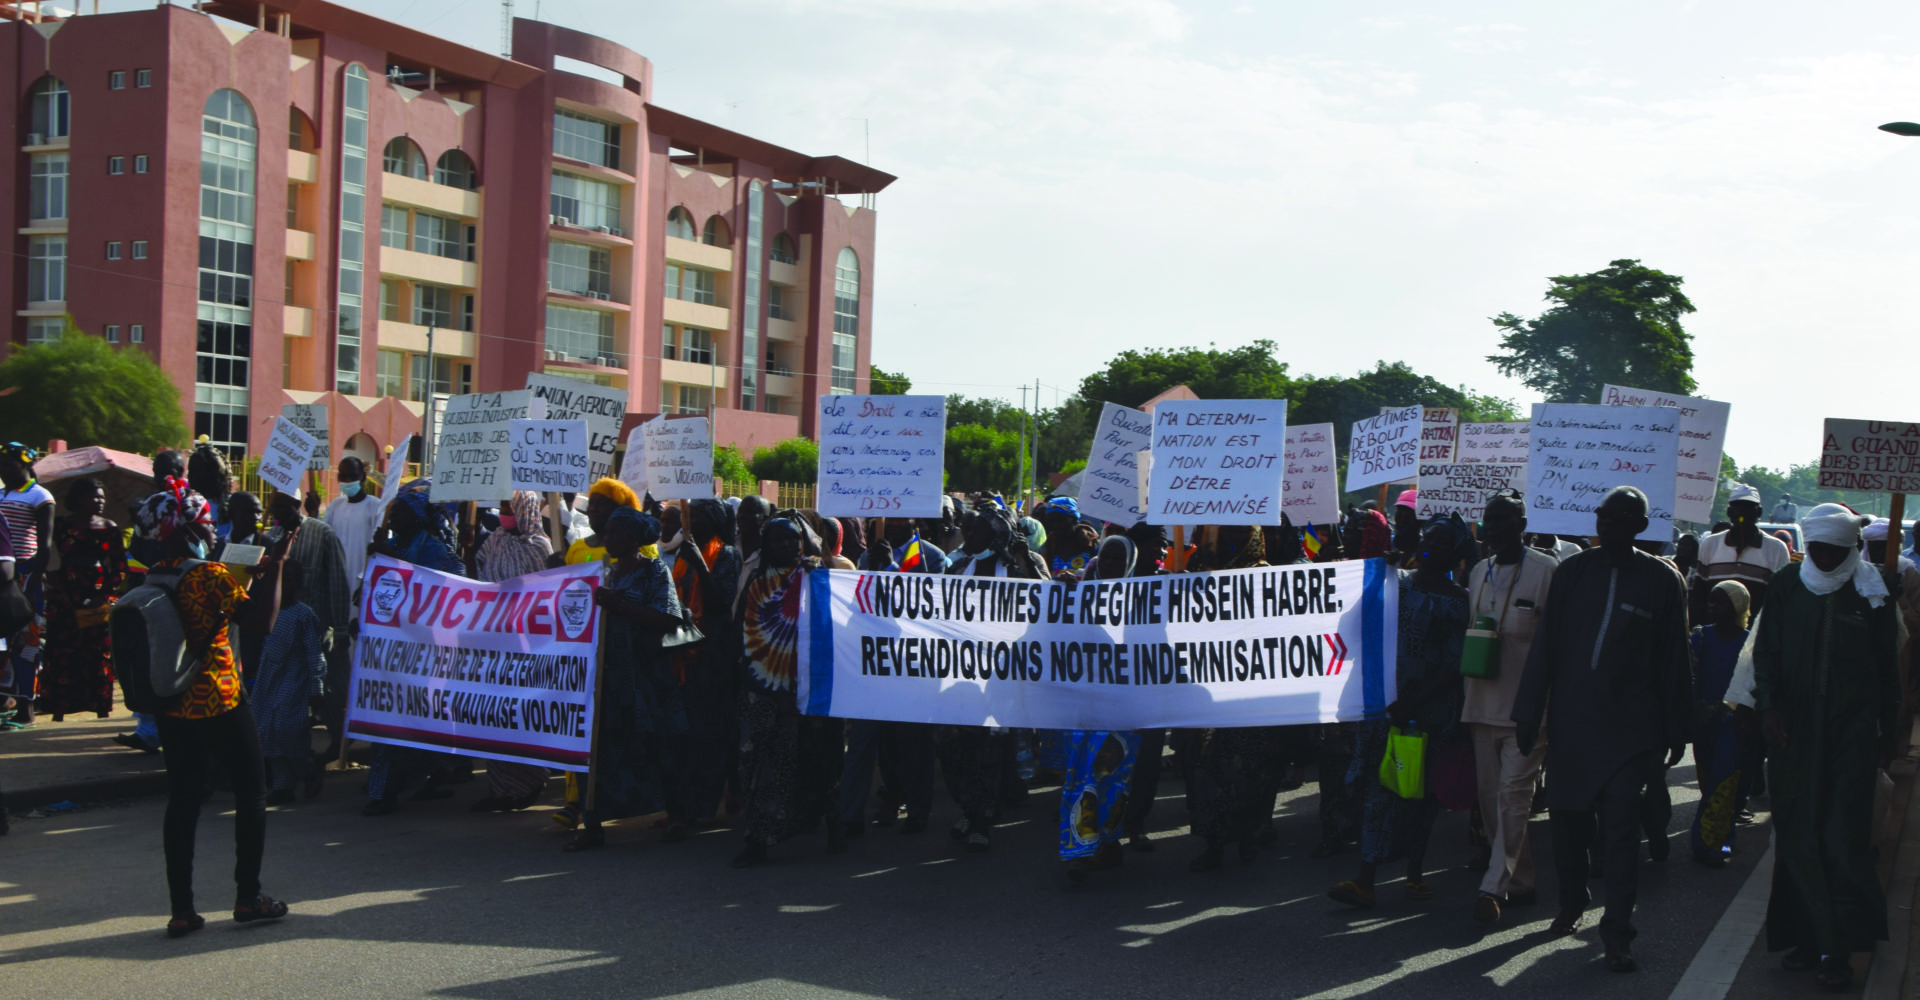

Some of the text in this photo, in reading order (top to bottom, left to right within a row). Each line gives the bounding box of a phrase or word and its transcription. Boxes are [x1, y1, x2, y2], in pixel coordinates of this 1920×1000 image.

[857, 398, 896, 418] Droit
[1422, 410, 1452, 424] LEIL
[1158, 411, 1179, 426] MA
[1357, 407, 1418, 434] VICTIMES
[1157, 434, 1217, 448] NATION
[1225, 434, 1261, 447] EST
[1421, 426, 1456, 442] RATION
[1823, 433, 1841, 451] A
[450, 448, 500, 464] VICTIMES
[534, 449, 564, 465] SONT
[567, 454, 588, 468] NOS
[1351, 438, 1418, 464] POUR VOS
[1168, 455, 1207, 470] MON
[1362, 452, 1415, 475] DROITS
[1419, 464, 1522, 478] GOUVERNEMENT
[1608, 457, 1657, 474] DROIT
[1821, 454, 1861, 470] DES
[440, 470, 455, 485] DE
[1446, 477, 1511, 490] TCHADIEN
[1539, 468, 1568, 489] PM
[1819, 471, 1885, 490] PEINES
[859, 496, 902, 511] DDS
[942, 578, 1042, 624] VICTIMES
[1047, 584, 1078, 625] DE
[1080, 580, 1163, 627] REGIME
[1168, 573, 1255, 623] HISSEIN
[1262, 567, 1343, 618] HABRE,
[408, 582, 556, 637] VICTIME
[384, 638, 426, 676] VENUE
[421, 643, 470, 683] L'HEURE
[467, 648, 486, 684] DE
[484, 649, 499, 684] TA
[499, 651, 588, 693] DETERMINATION
[861, 635, 1043, 681] REVENDIQUONS
[1050, 641, 1129, 685] NOTRE
[356, 678, 587, 739] APRES 6 ANS DE MAUVAISE VOLONTE
